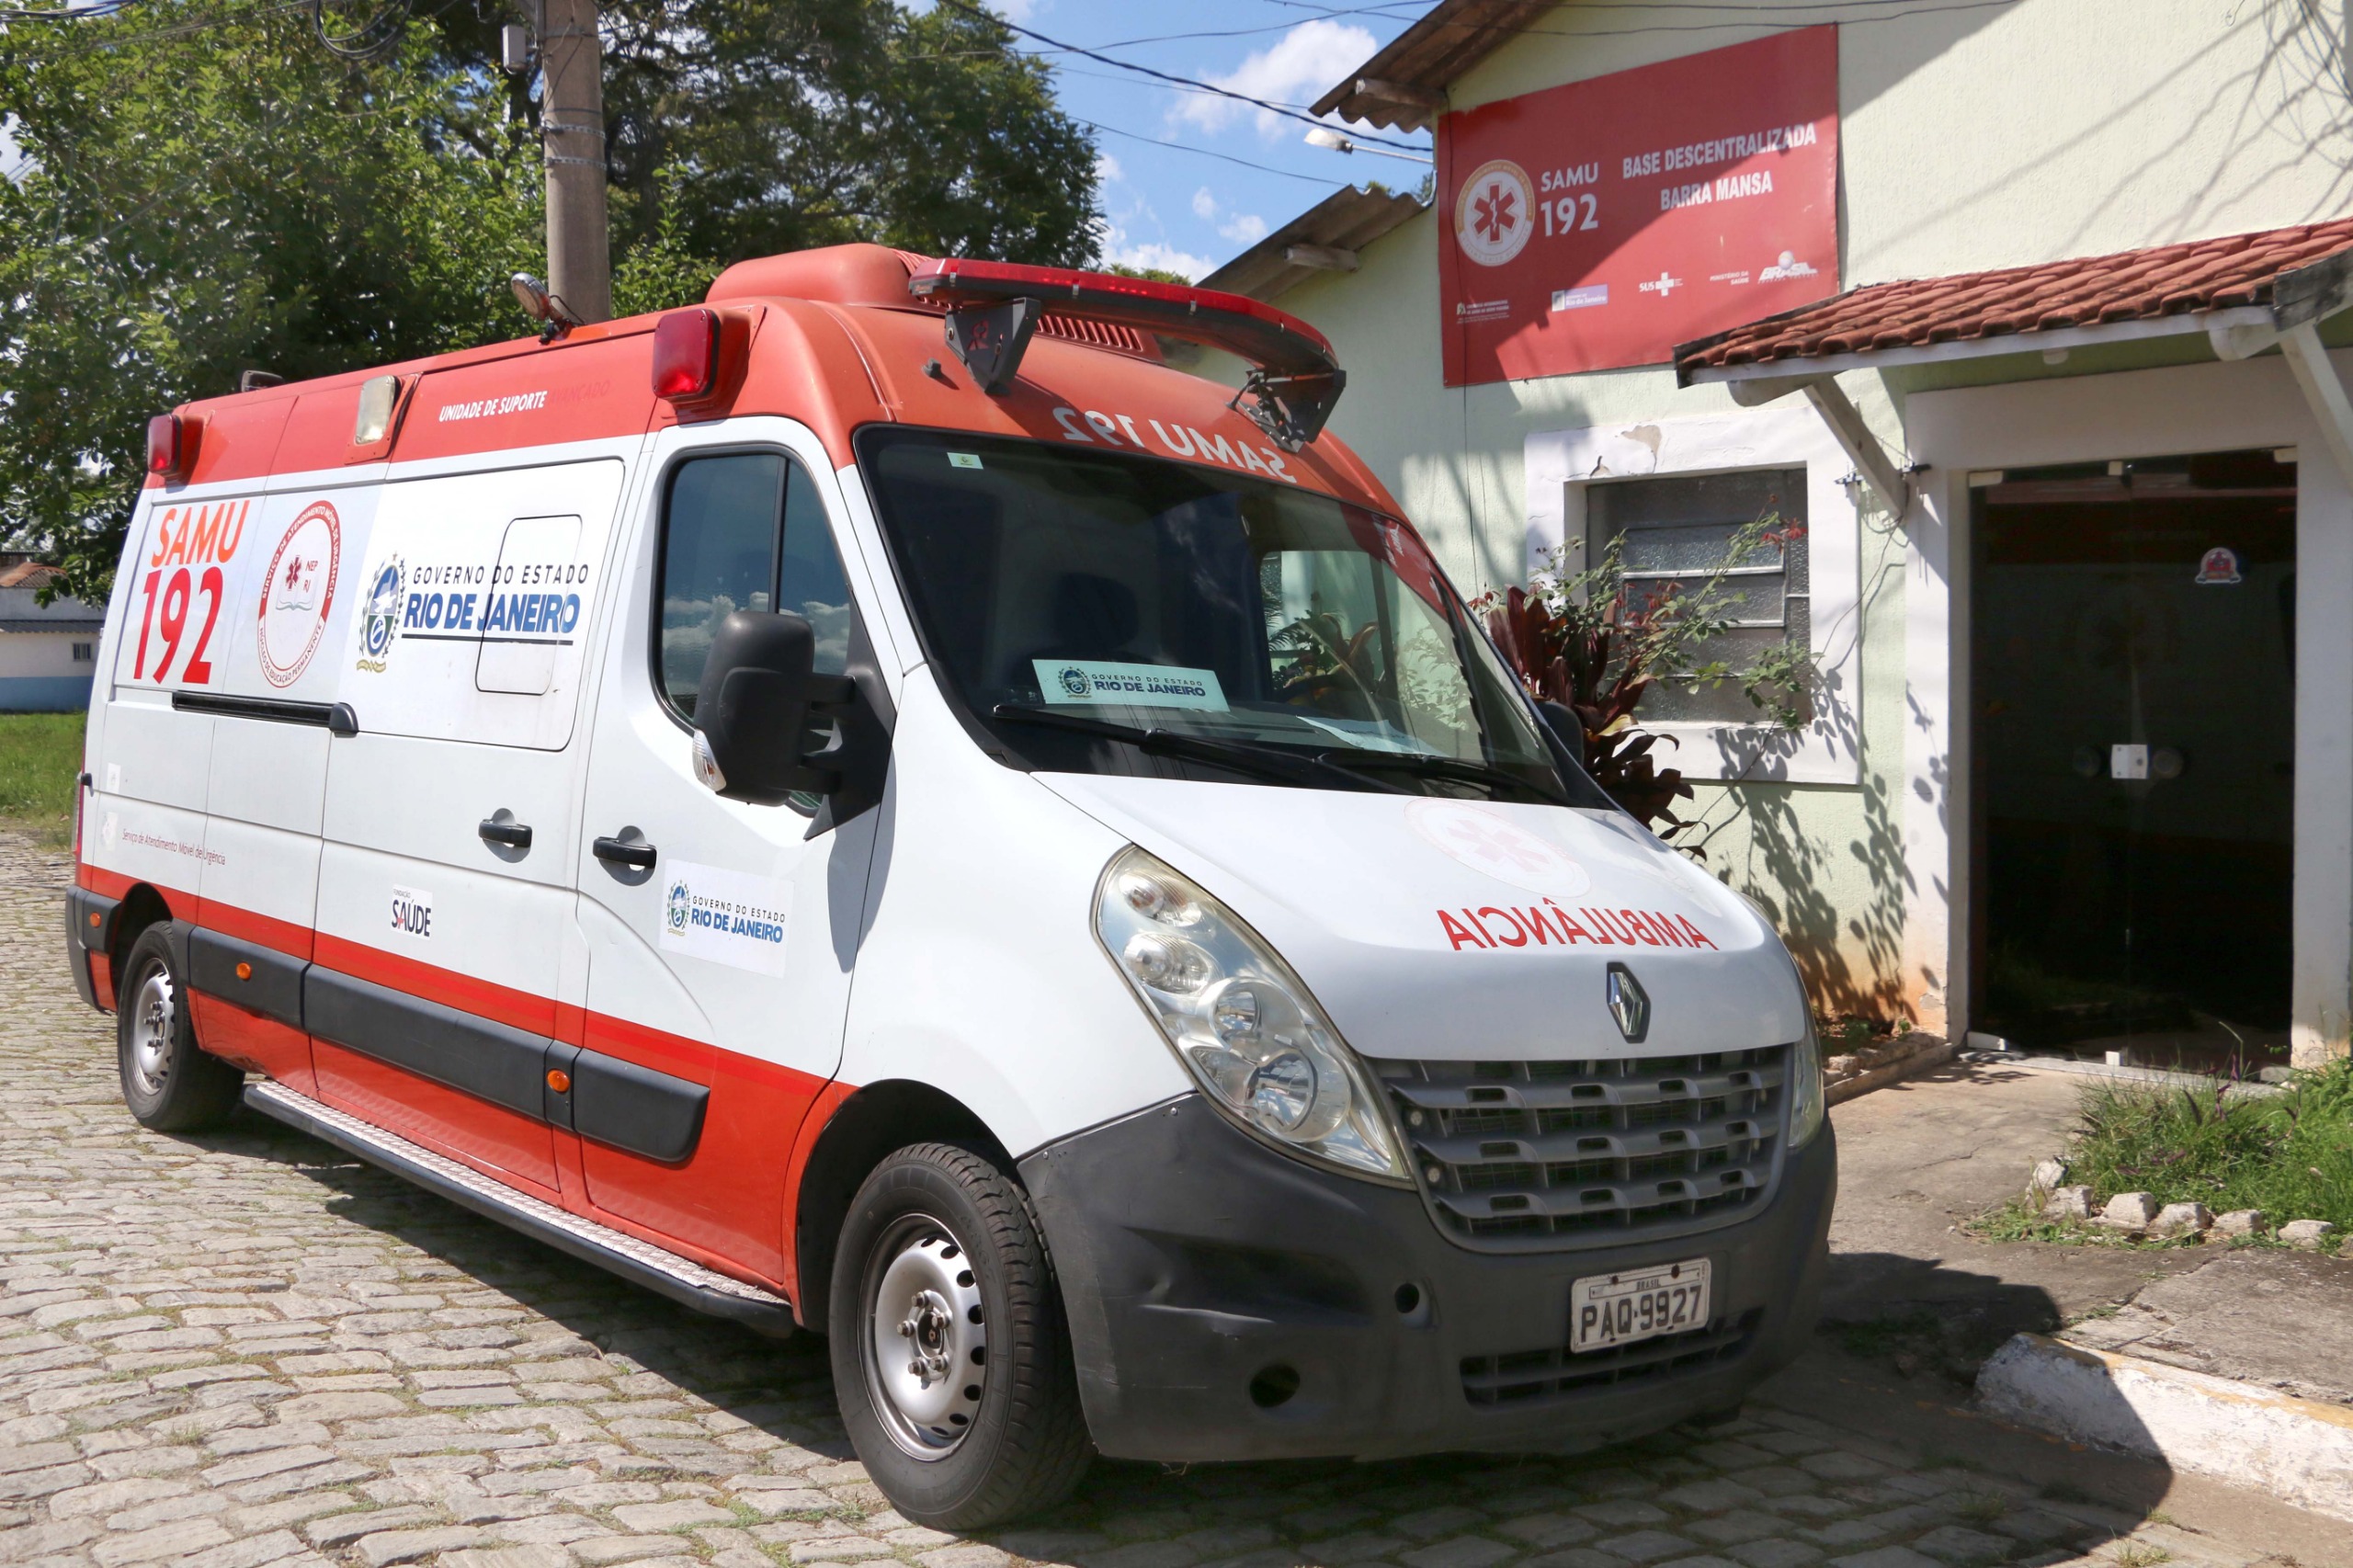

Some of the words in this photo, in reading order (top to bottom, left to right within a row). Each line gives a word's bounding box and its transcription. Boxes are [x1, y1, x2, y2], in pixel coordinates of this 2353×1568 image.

[1622, 151, 1661, 179] BASE
[1665, 122, 1816, 173] DESCENTRALIZADA
[1540, 162, 1599, 192] SAMU
[1660, 181, 1712, 211] BARRA
[1716, 170, 1773, 201] MANSA
[1540, 193, 1599, 237] 192
[1639, 281, 1655, 292] SUS
[438, 401, 484, 423] UNIDADE
[483, 398, 499, 417] DE
[497, 390, 548, 415] SUPORTE
[151, 500, 250, 568] SAMU
[413, 565, 484, 585] GOVERNO
[494, 565, 514, 585] DO
[522, 564, 588, 585] ESTADO
[133, 566, 223, 685] 192
[403, 592, 443, 630] RIO
[444, 593, 477, 630] DE
[477, 593, 580, 633] JANEIRO
[1091, 674, 1142, 682] GOVERNO
[1165, 677, 1203, 687] ESTADO
[1094, 681, 1121, 691] RIO
[1124, 682, 1143, 692] DE
[1147, 683, 1206, 697] JANEIRO
[392, 899, 431, 937] SAÚDE
[691, 908, 711, 927] RIO
[713, 913, 730, 931] DE
[731, 916, 783, 943] JANEIRO
[692, 895, 732, 912] GOVERNO
[735, 904, 746, 915] DO
[751, 907, 786, 924] ESTADO
[1636, 1278, 1661, 1290] BRASIL
